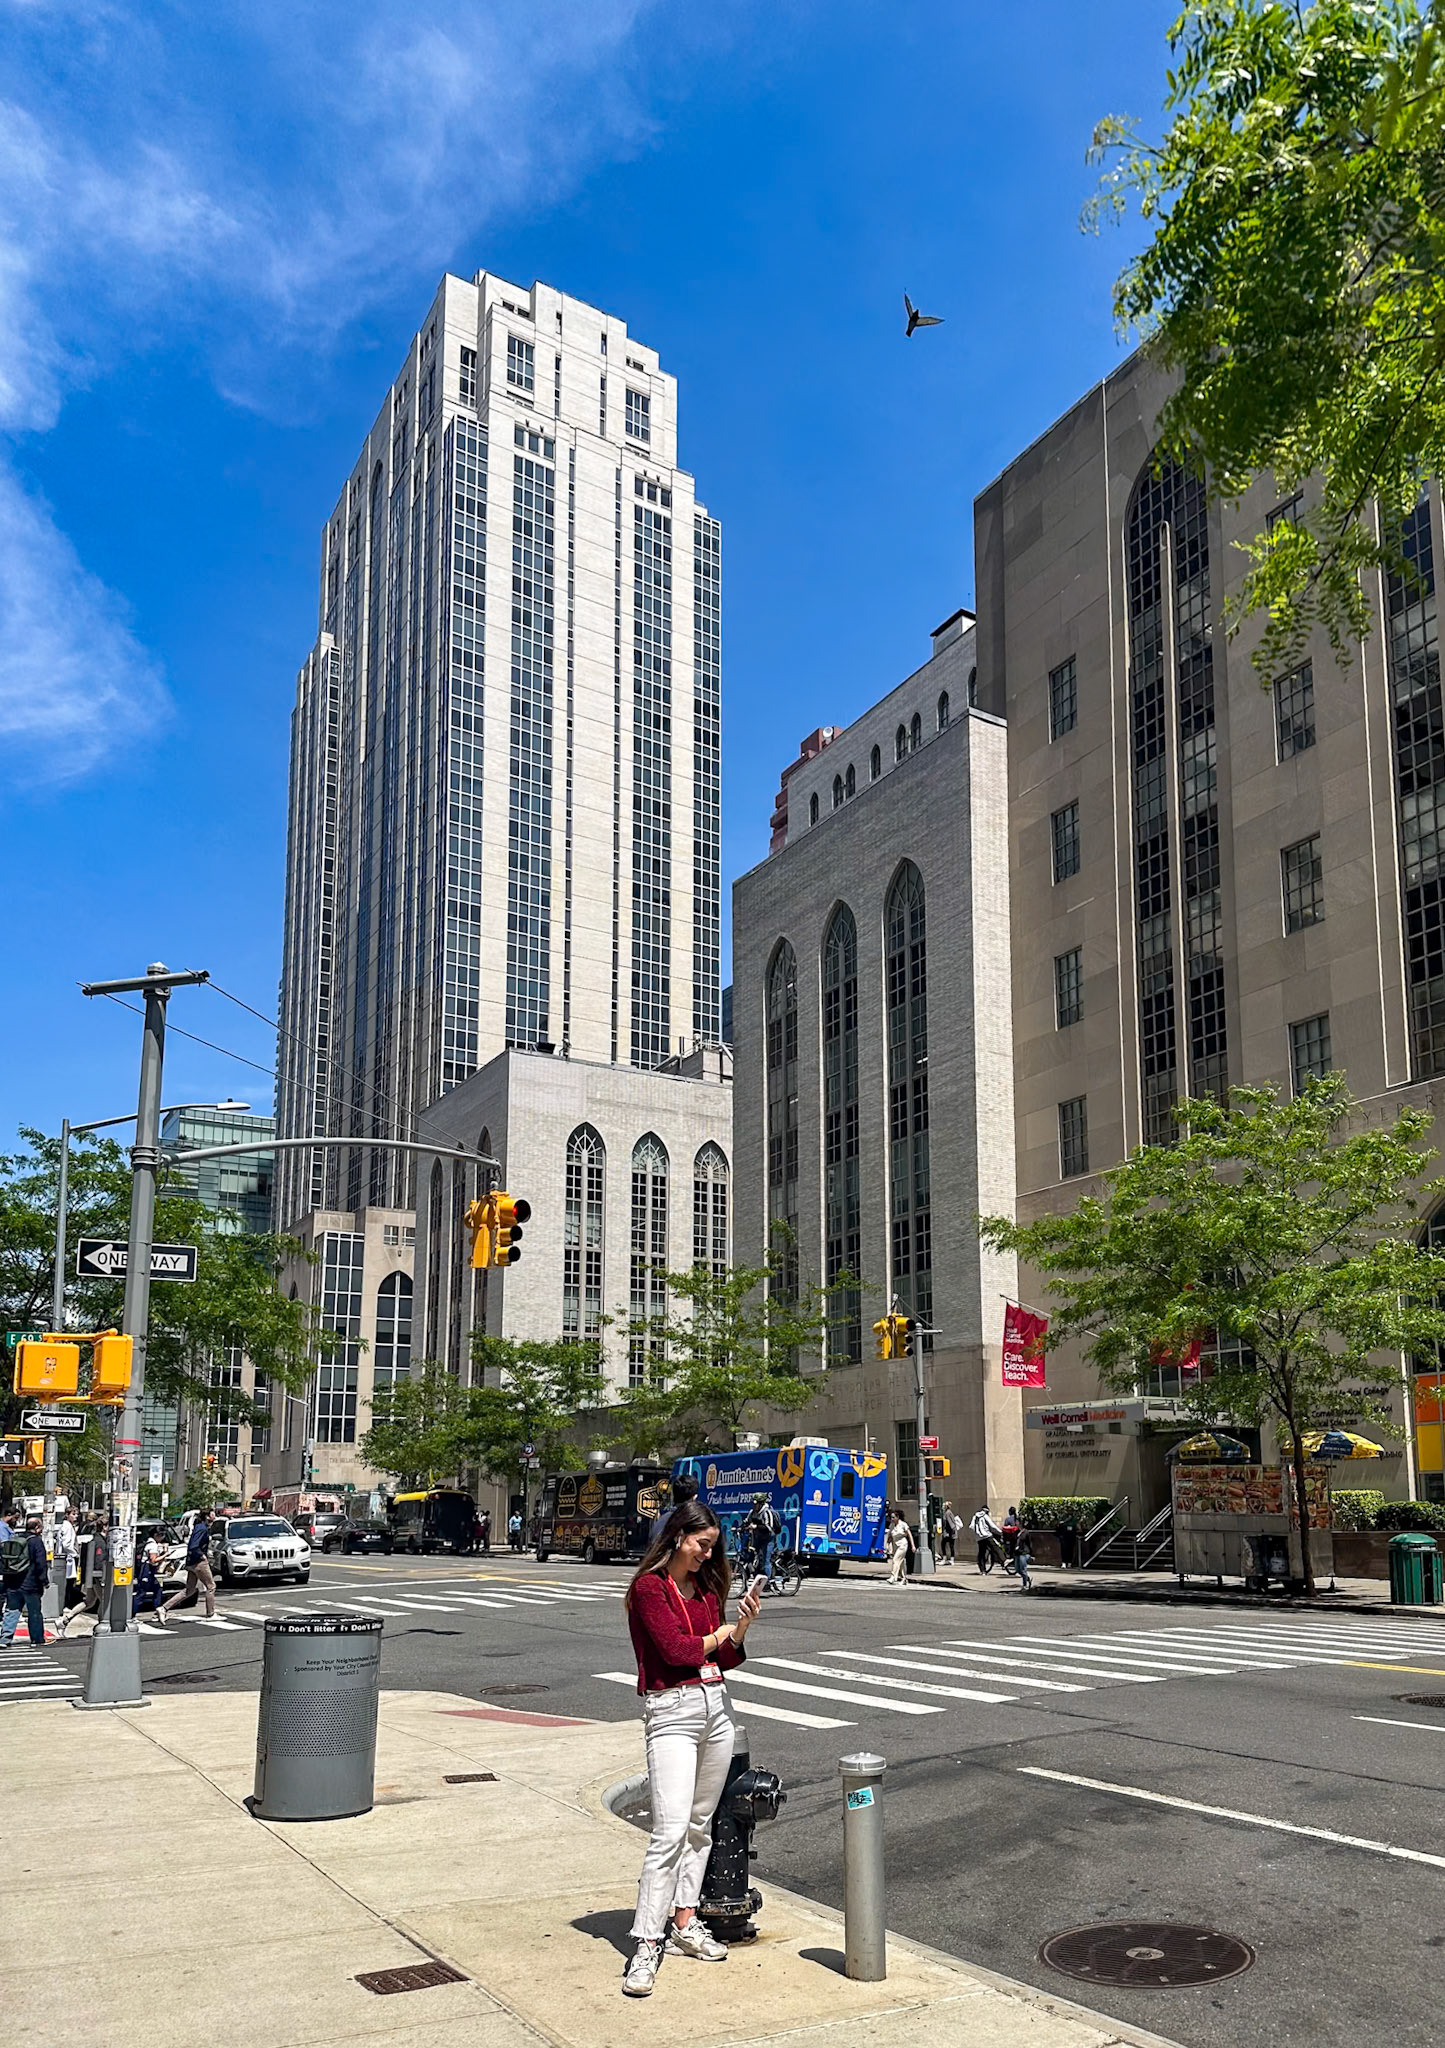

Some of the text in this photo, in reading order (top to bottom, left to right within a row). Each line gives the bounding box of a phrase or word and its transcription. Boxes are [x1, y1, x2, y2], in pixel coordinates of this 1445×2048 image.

[97, 1252, 128, 1266] ONE
[10, 1334, 16, 1345] E
[1004, 1352, 1024, 1362] Care.
[1004, 1361, 1039, 1373] Discover.
[1004, 1371, 1029, 1381] Teach.
[32, 1417, 77, 1427] ONE WAY
[1041, 1408, 1126, 1425] Weill Cornell Medicine
[832, 1518, 860, 1536] Roll
[288, 1625, 311, 1633] Don't
[313, 1625, 336, 1633] litter
[351, 1623, 370, 1632] Don't
